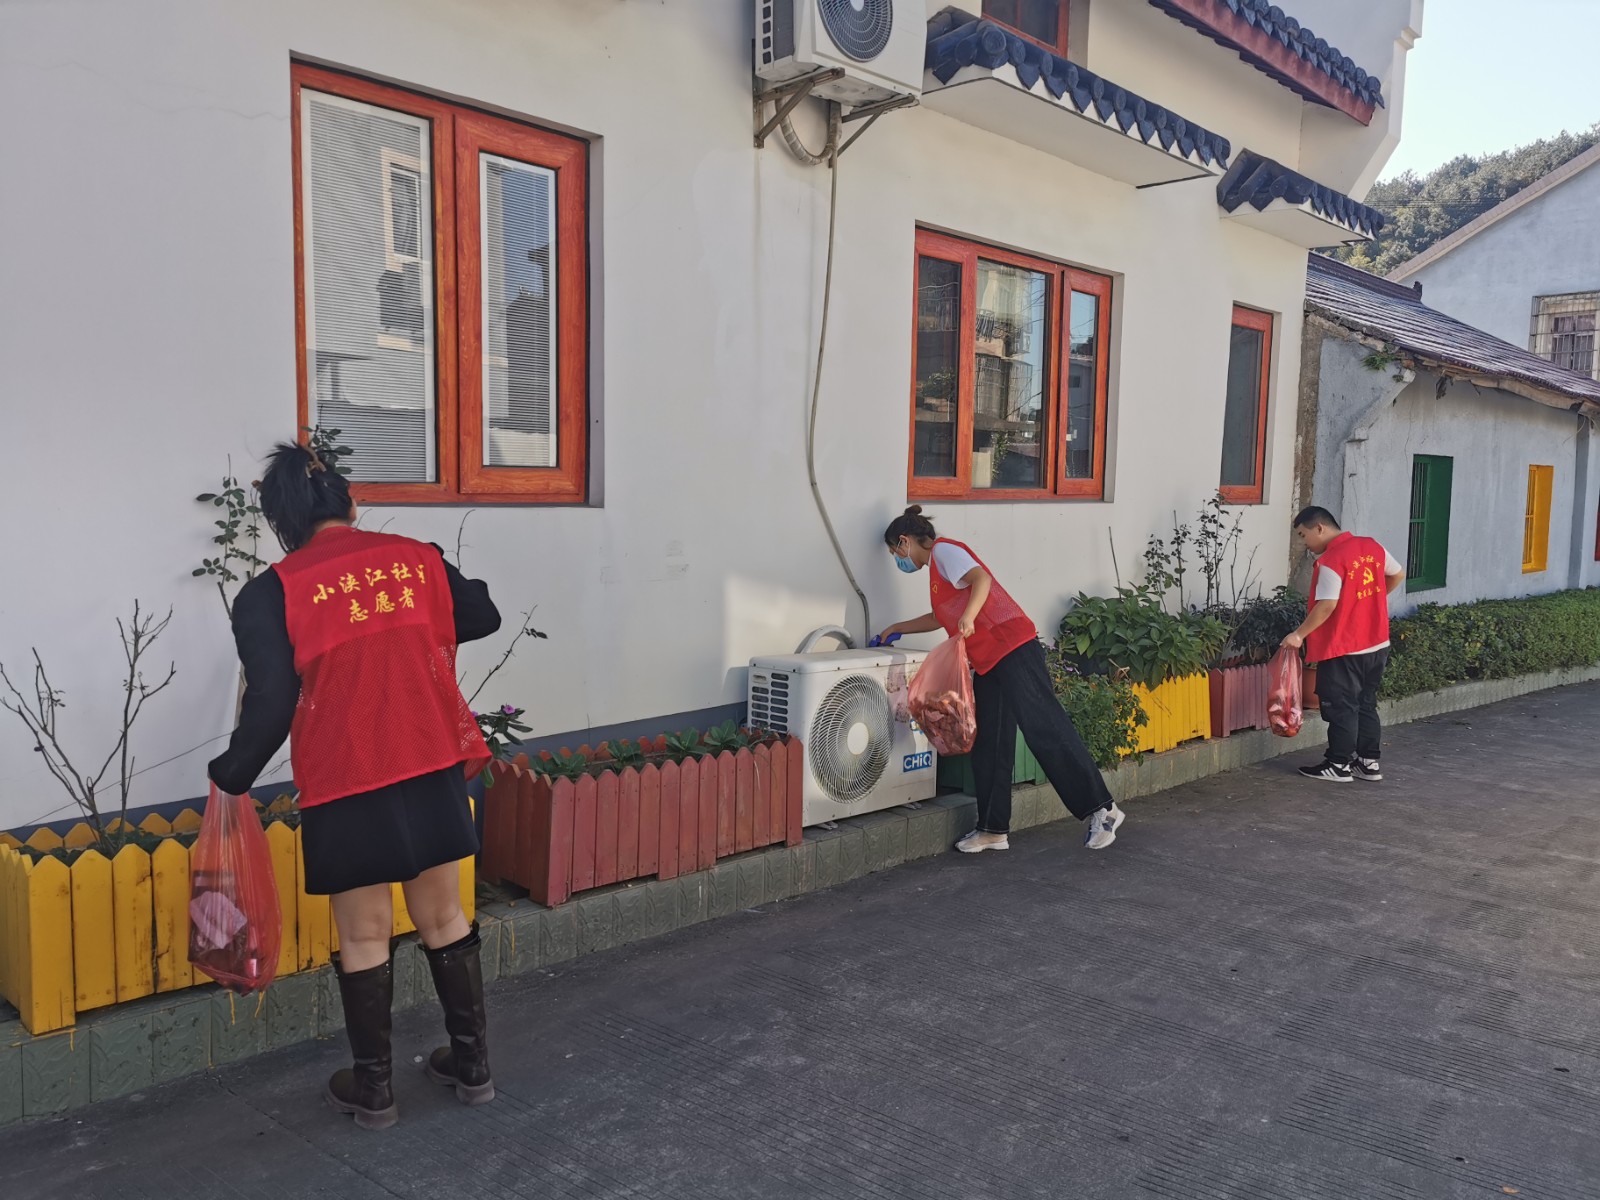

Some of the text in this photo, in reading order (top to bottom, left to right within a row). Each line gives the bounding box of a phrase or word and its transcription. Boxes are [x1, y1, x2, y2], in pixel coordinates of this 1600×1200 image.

[349, 586, 415, 624] 志愿者
[904, 753, 932, 769] CHiQ
